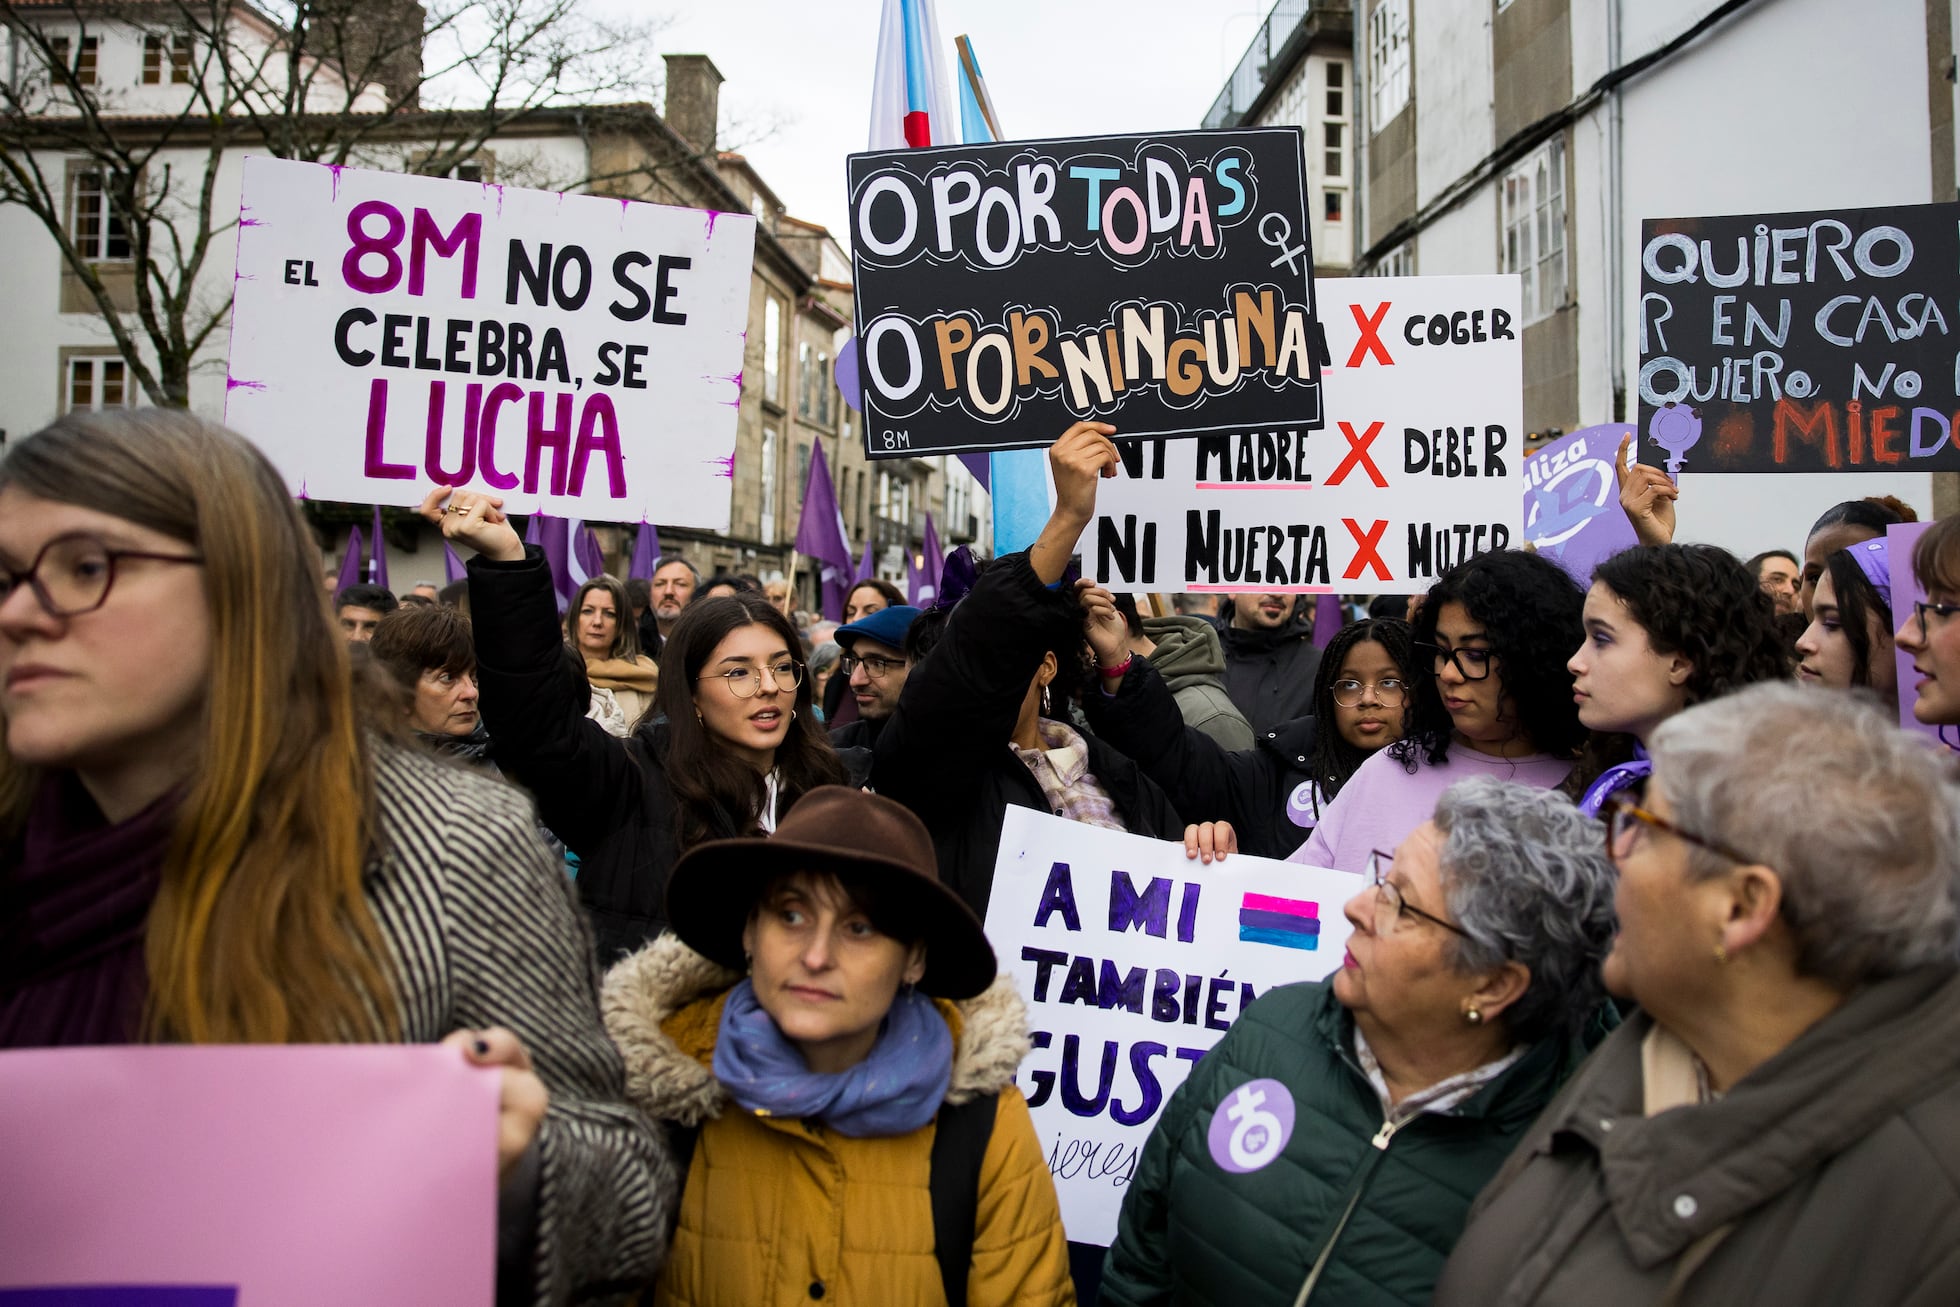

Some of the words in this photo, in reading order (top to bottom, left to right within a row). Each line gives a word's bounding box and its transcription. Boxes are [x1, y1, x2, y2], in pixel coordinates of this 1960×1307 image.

[859, 176, 919, 256] O
[931, 163, 1062, 266] POR
[1069, 156, 1246, 255] TODAS
[284, 258, 319, 287] EL
[341, 200, 482, 300] 8M
[505, 238, 592, 311] NO
[608, 250, 692, 326] SE
[334, 307, 583, 391] CELEBRA,
[593, 340, 650, 389] SE
[866, 317, 923, 400] O
[934, 311, 1060, 415] POR
[1060, 290, 1311, 410] NINGUNA
[1404, 308, 1515, 346] COGER
[1712, 295, 1792, 348] EN
[1814, 293, 1949, 347] CASA
[364, 378, 628, 498] LUCHA
[882, 430, 911, 450] 8M
[1196, 431, 1312, 482] MADRE
[1404, 424, 1507, 478] DEBER
[1097, 514, 1157, 584] NI
[1185, 510, 1331, 585] MUERTA
[1033, 862, 1082, 932] A
[1108, 870, 1201, 943] MI
